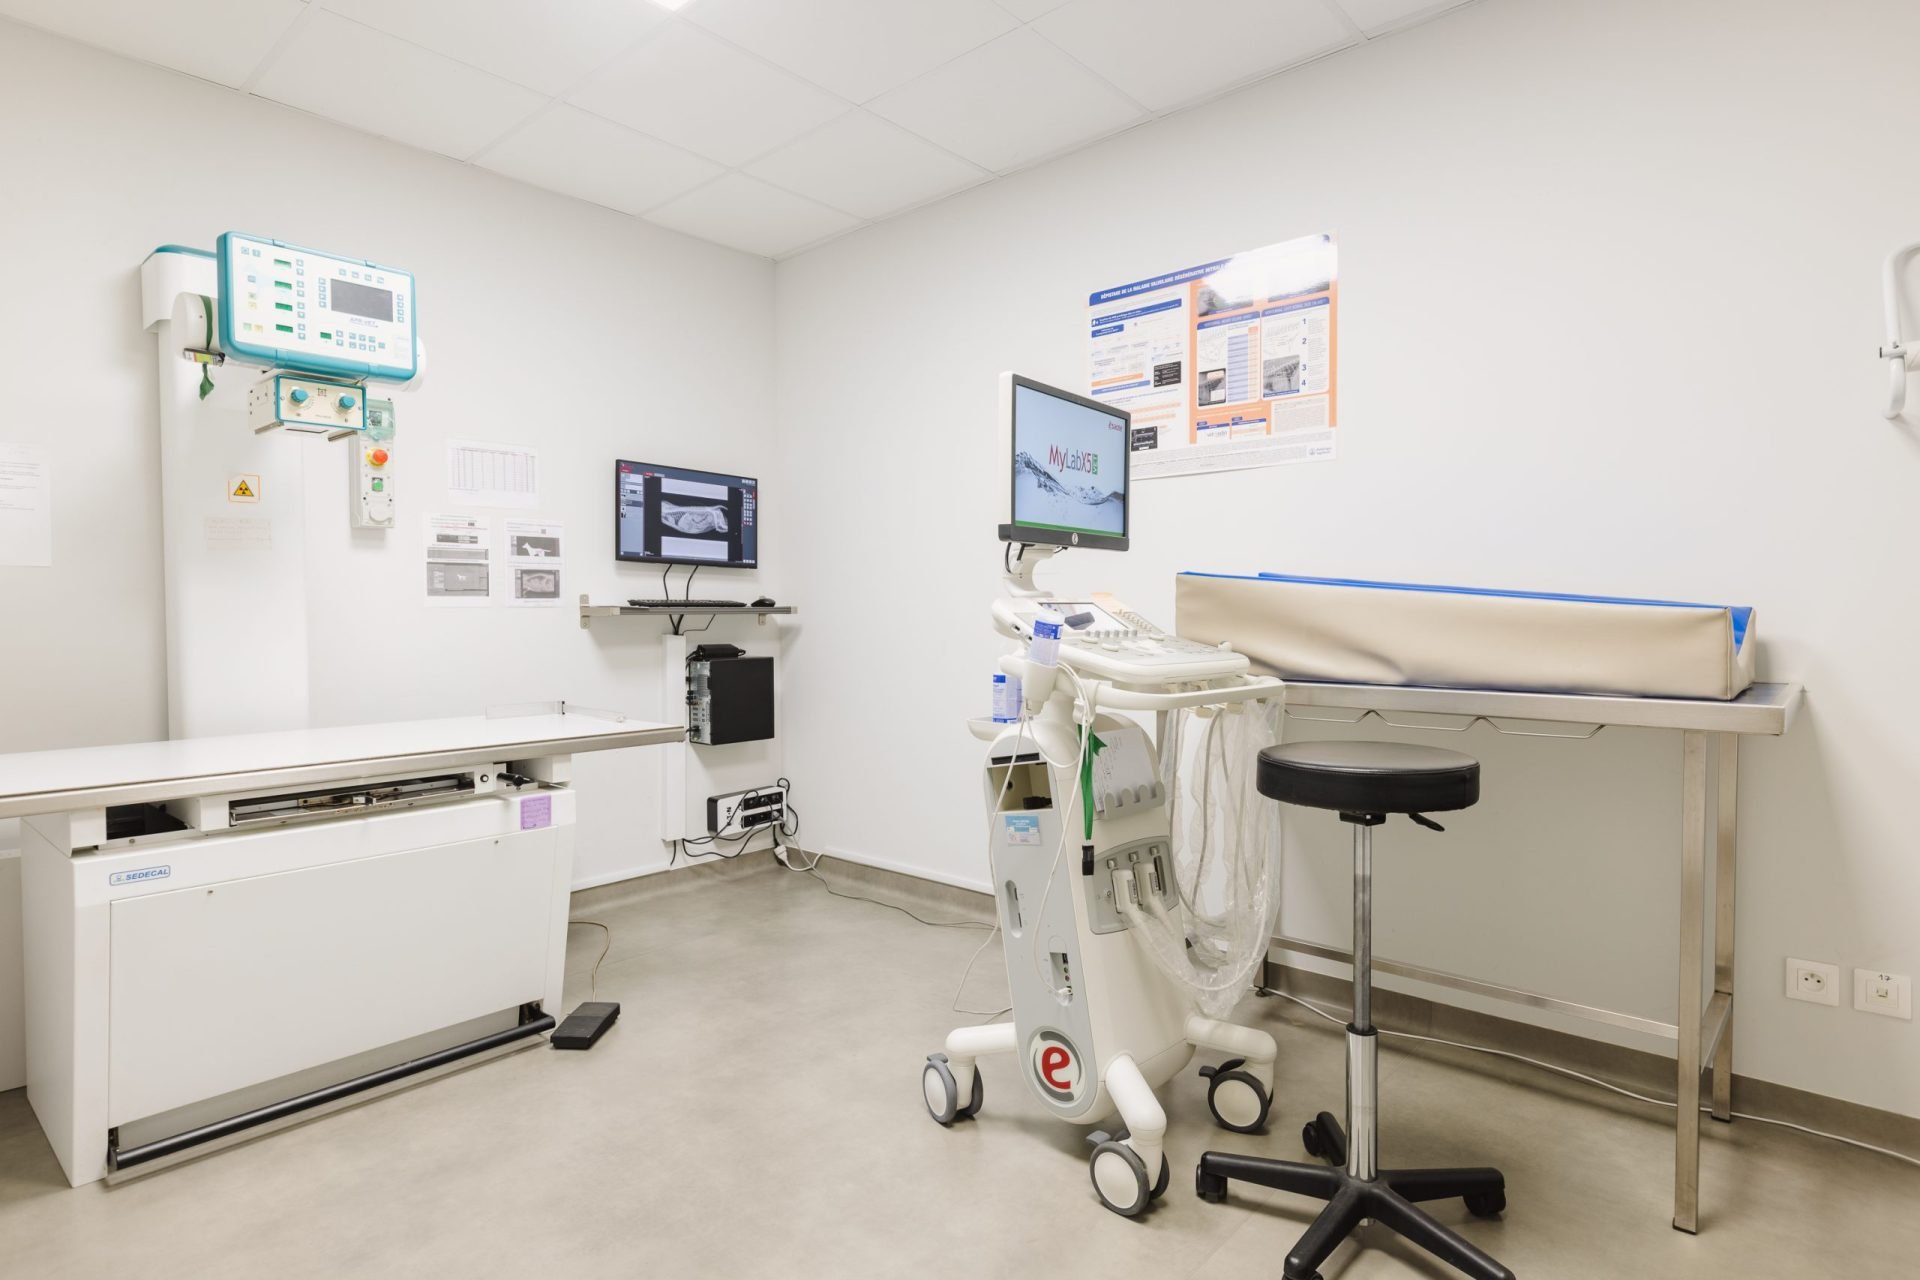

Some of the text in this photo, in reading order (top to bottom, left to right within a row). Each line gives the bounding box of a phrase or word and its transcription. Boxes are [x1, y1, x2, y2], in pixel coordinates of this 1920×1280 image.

[1302, 337, 1307, 345] 2
[126, 868, 169, 881] SEDECAL
[1041, 1046, 1071, 1089] e
